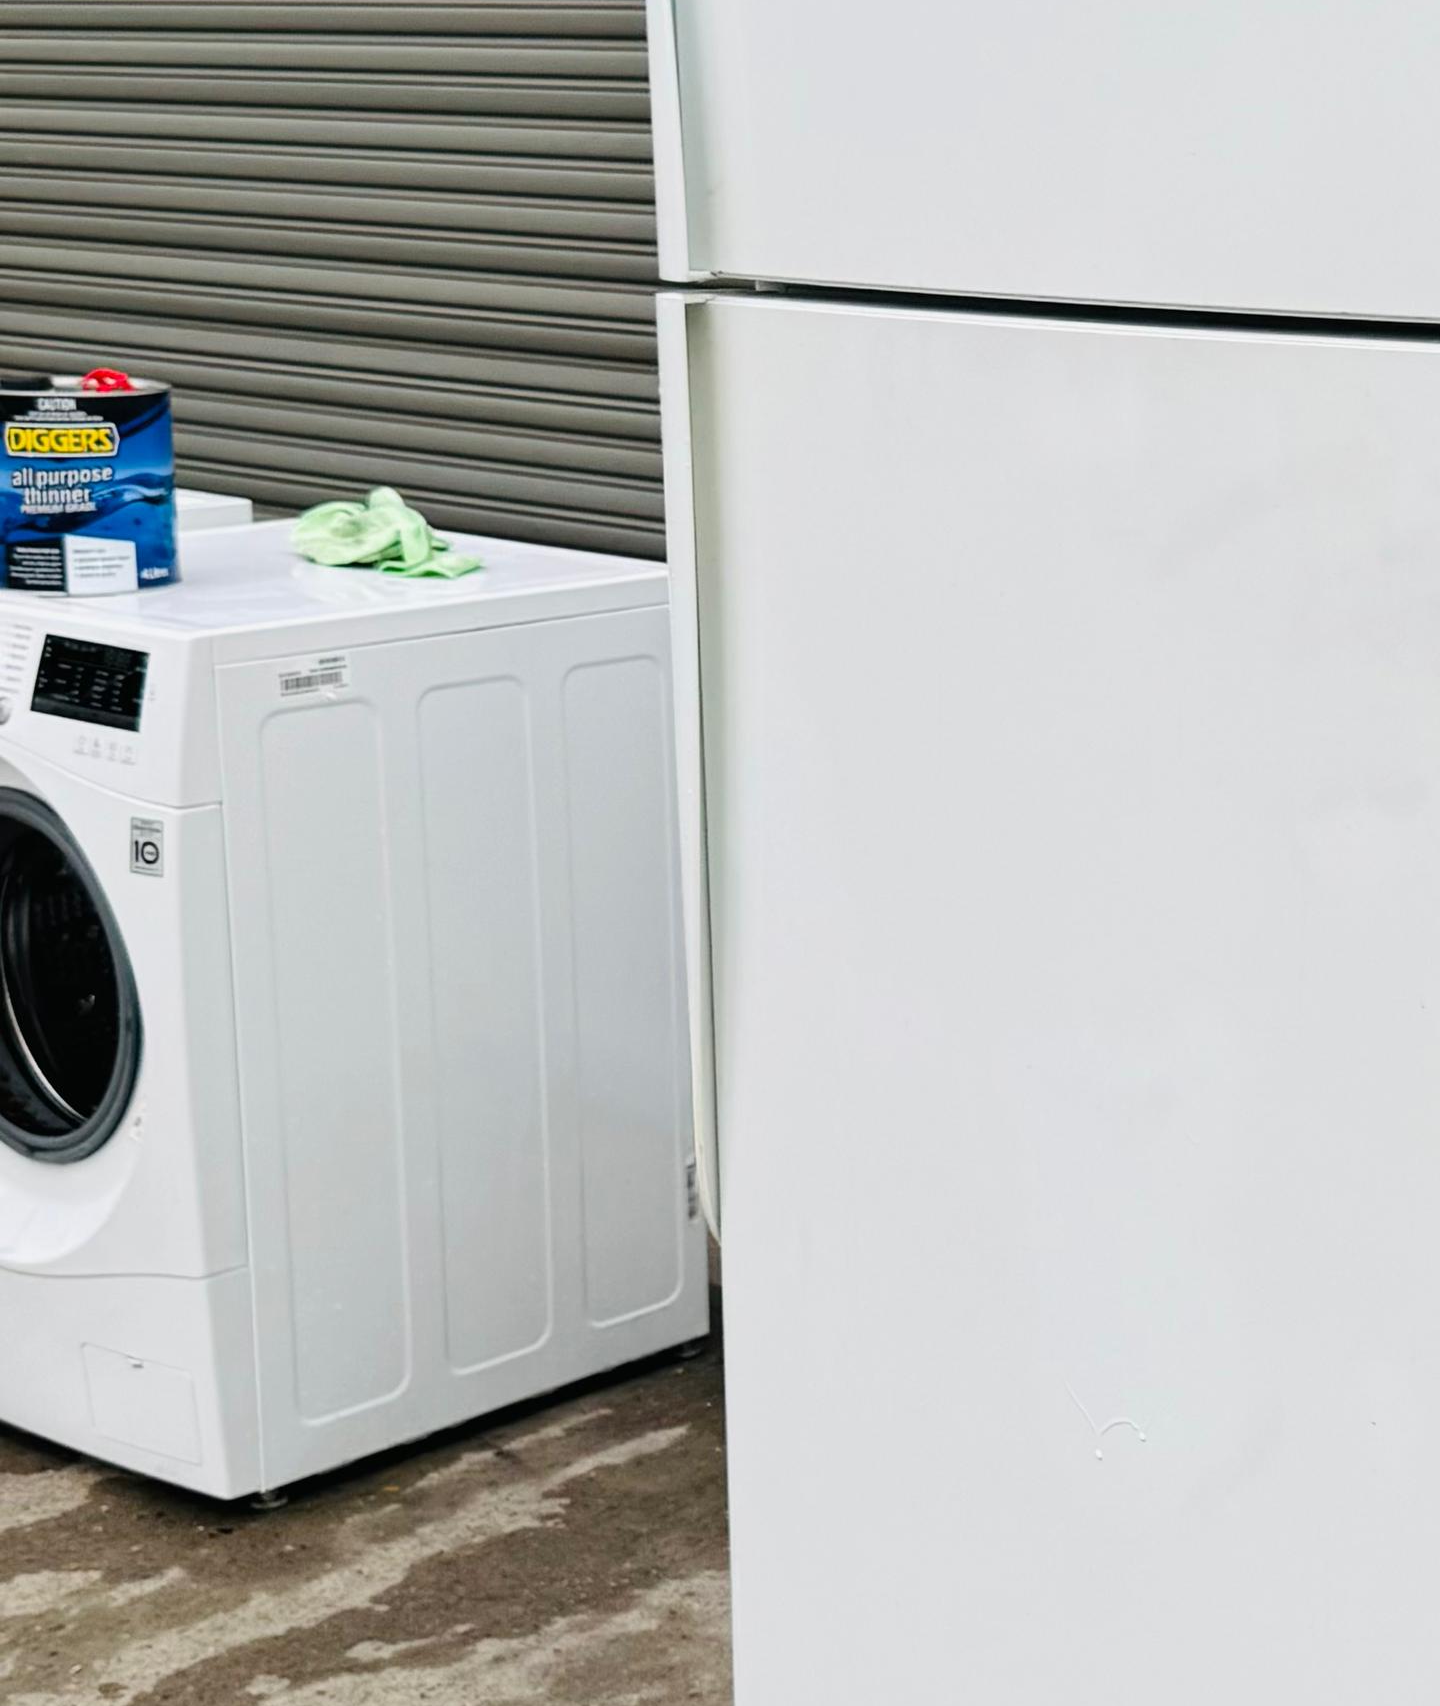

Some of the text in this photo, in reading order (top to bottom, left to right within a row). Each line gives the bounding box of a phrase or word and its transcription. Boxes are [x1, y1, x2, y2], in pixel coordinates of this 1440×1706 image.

[9, 428, 114, 453] DIGGERS
[12, 467, 113, 489] all purpose
[24, 487, 92, 504] thinner
